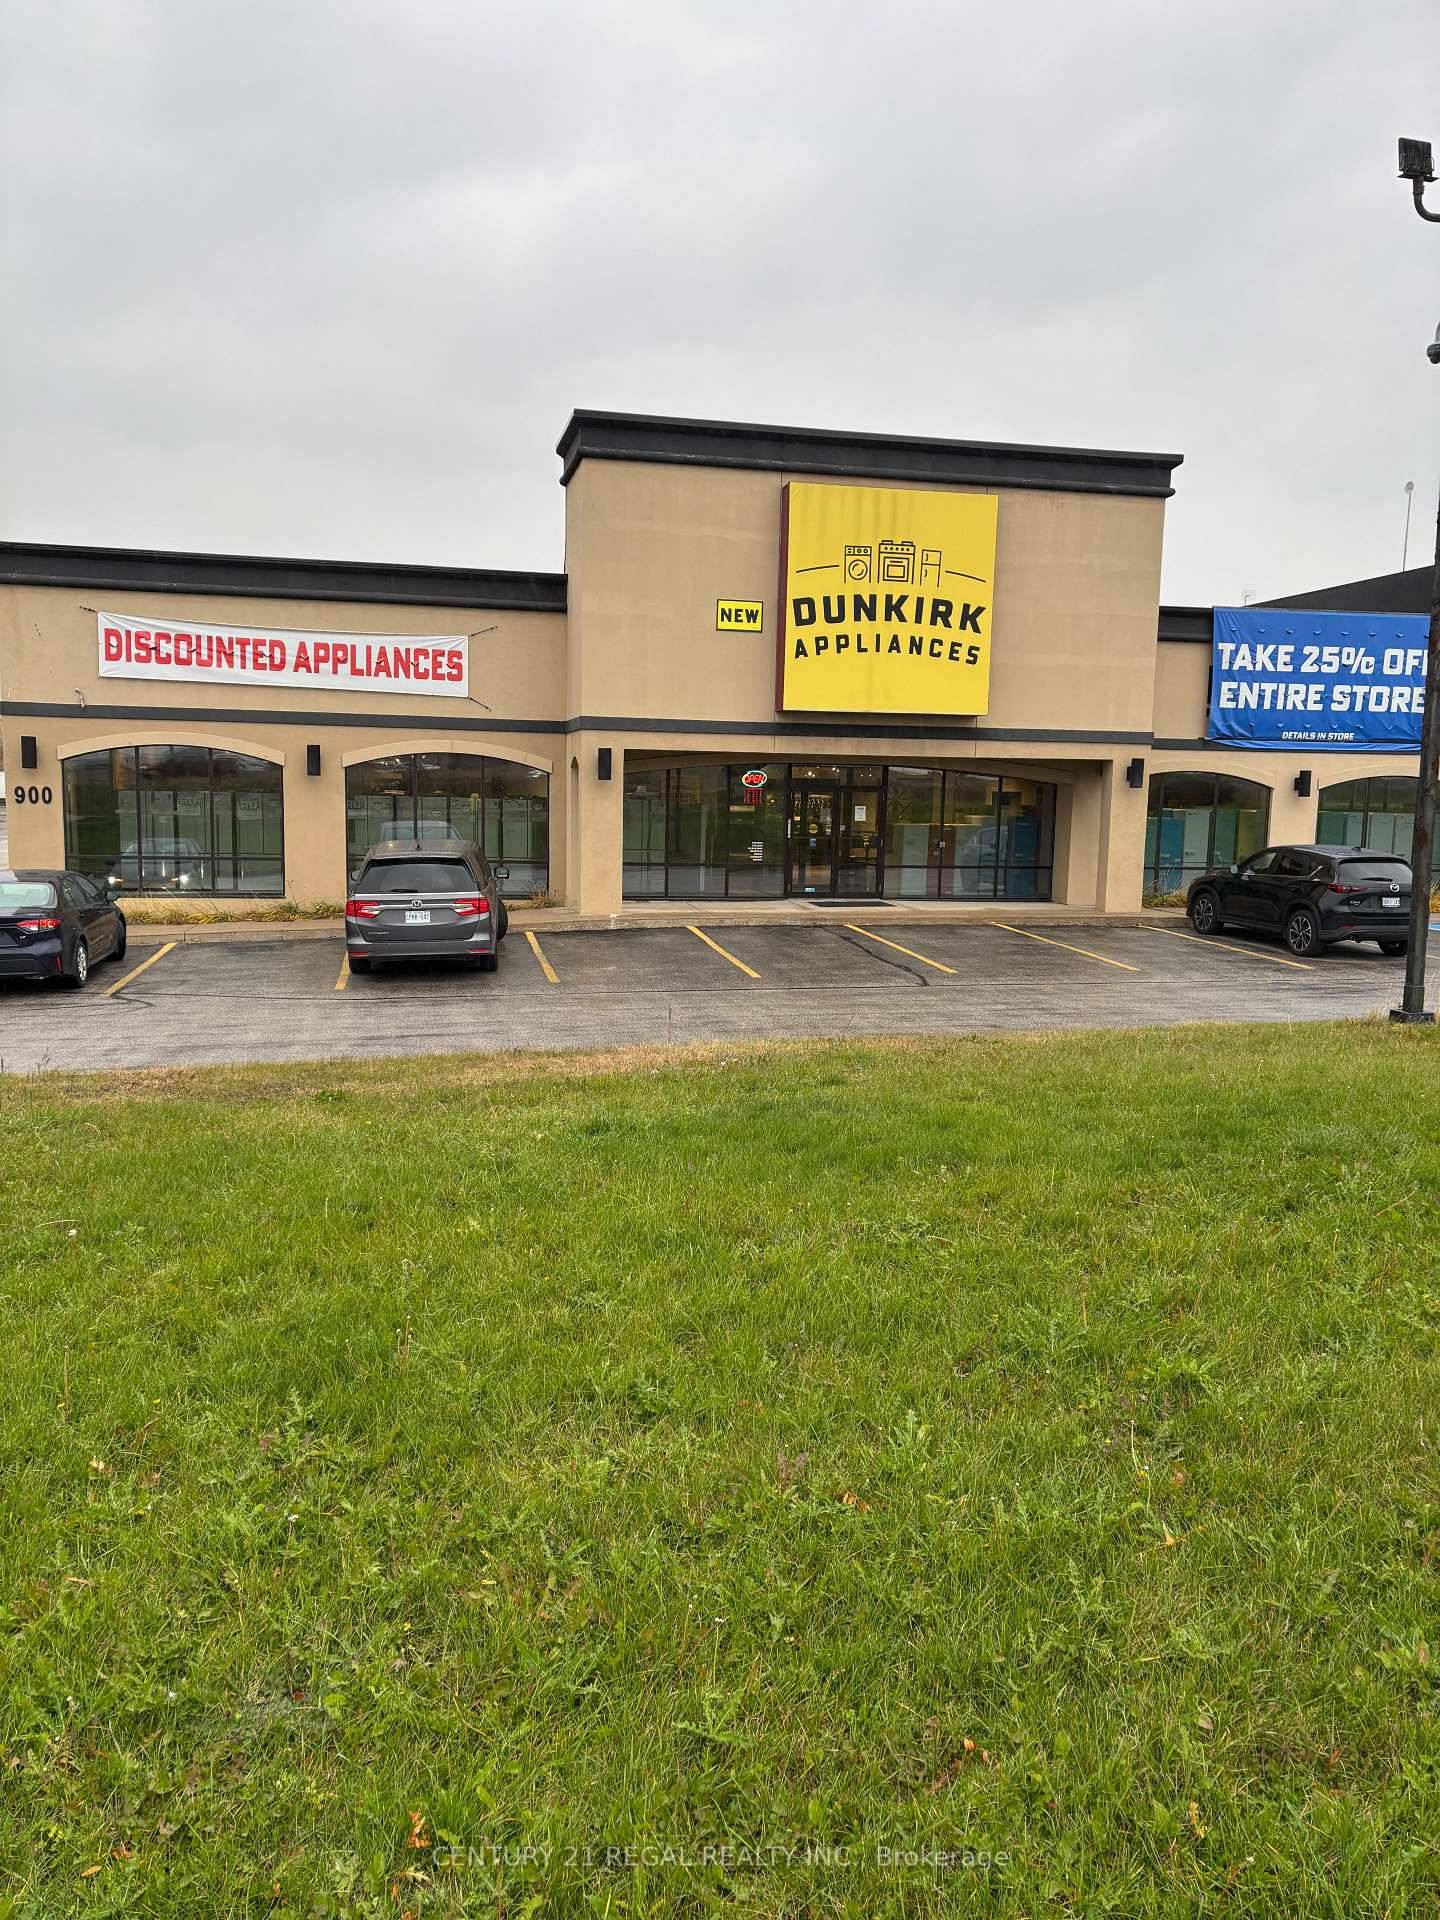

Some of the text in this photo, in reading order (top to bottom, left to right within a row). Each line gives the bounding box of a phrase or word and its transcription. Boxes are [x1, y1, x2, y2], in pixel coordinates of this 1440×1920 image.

[720, 607, 759, 624] NEW
[792, 593, 986, 635] DUNKIRK
[103, 627, 464, 682] DISCOUNTED APPLIANCES
[794, 633, 981, 665] APPLIANCES
[1218, 642, 1294, 673] TAKE
[1300, 645, 1376, 675] 25%
[1219, 681, 1426, 714] ENTIRE STORE
[1282, 731, 1355, 740] DETAILS IN STORE
[14, 785, 53, 804] 900
[744, 774, 765, 784] OPEN
